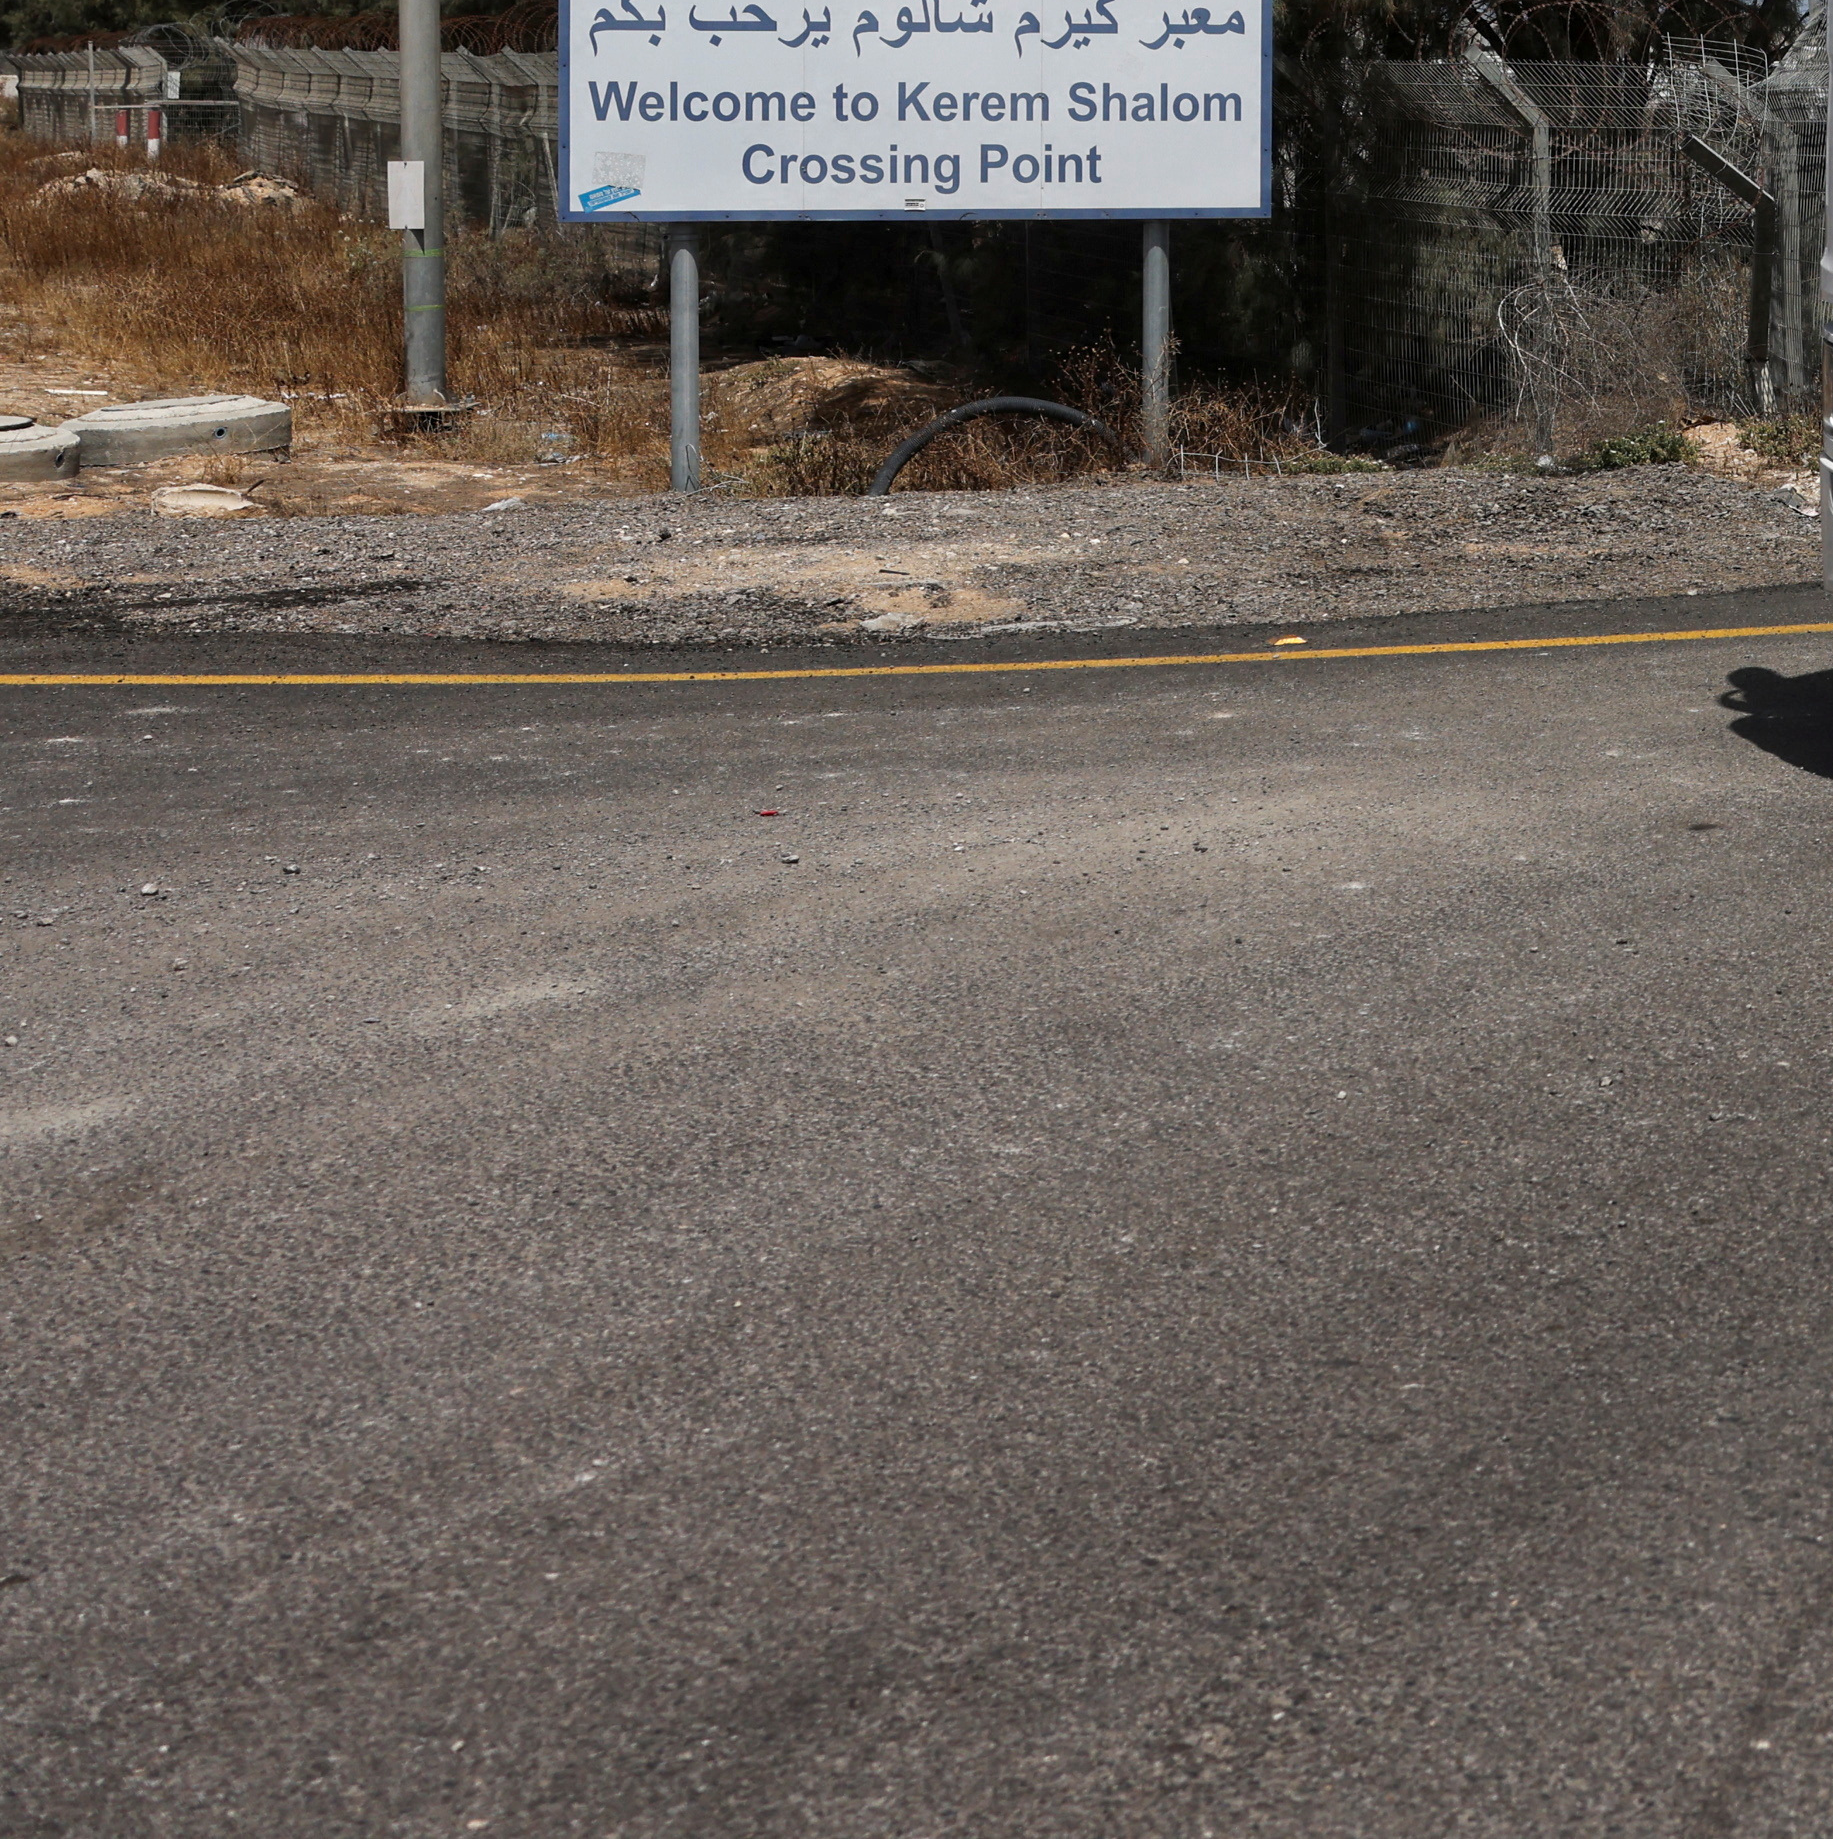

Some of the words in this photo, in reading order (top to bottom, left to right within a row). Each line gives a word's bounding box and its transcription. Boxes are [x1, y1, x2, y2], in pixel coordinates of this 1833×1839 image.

[688, 4, 832, 49] يرحب
[1138, 7, 1246, 50] معبر
[588, 81, 817, 122] Welcome
[832, 83, 879, 122] to
[898, 81, 1050, 122] Kerem
[1067, 82, 1243, 122] Shalom
[742, 143, 961, 195] Crossing
[979, 144, 1102, 183] Point
